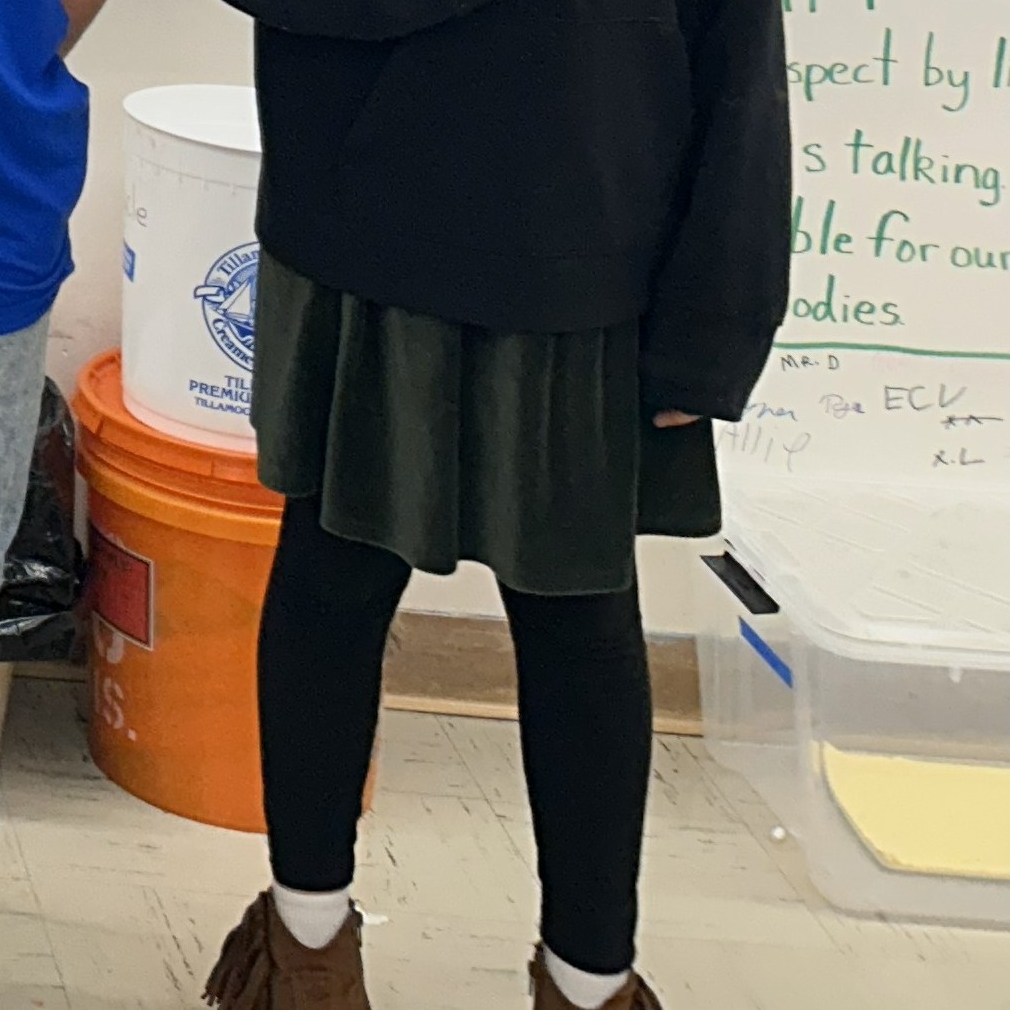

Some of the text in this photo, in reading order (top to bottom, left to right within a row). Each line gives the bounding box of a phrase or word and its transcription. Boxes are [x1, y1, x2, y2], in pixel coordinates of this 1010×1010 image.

[924, 31, 970, 112] by
[866, 210, 940, 258] for
[828, 354, 840, 370] D
